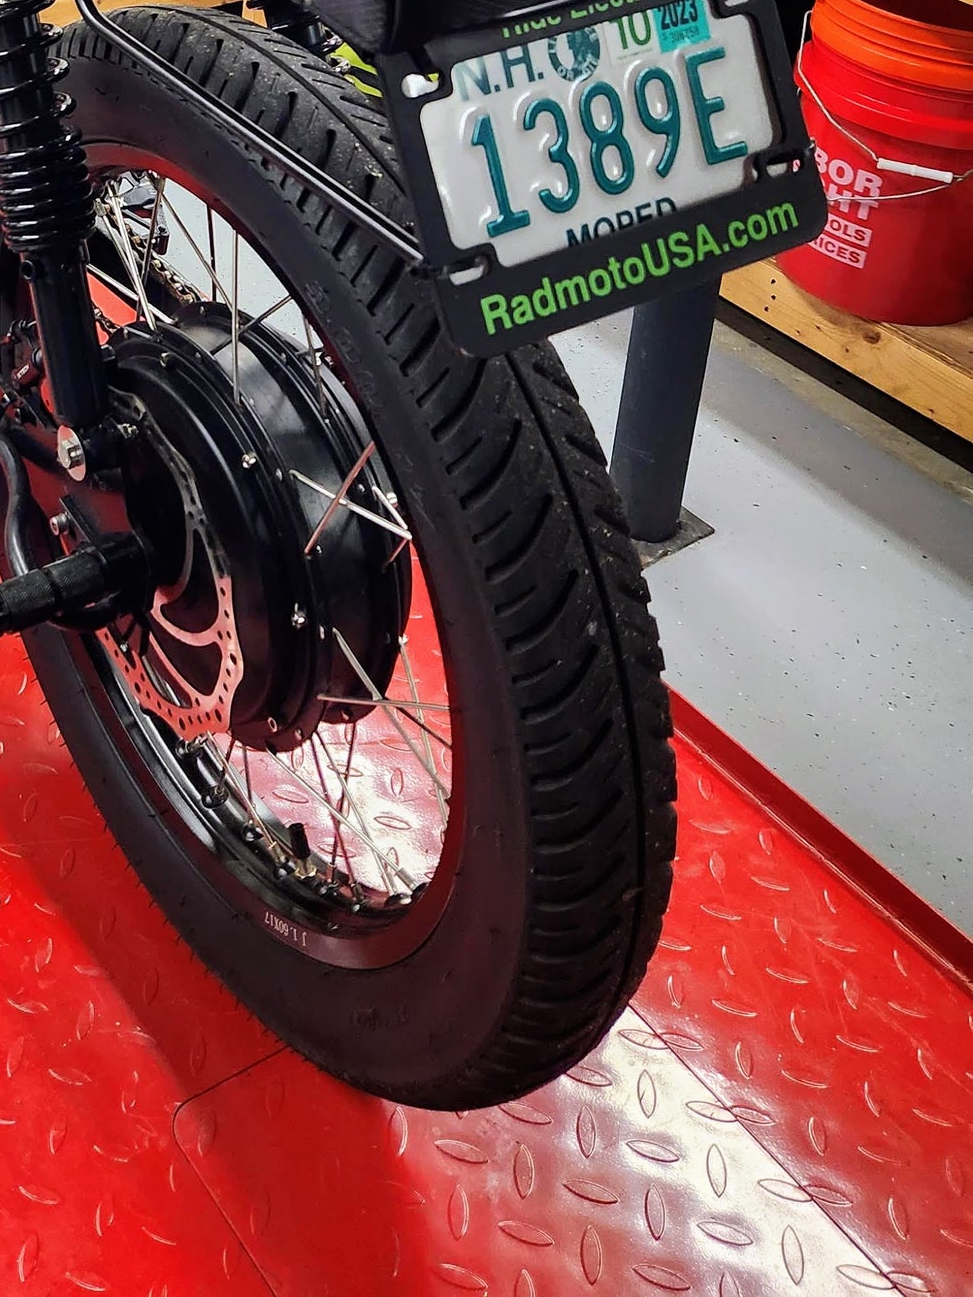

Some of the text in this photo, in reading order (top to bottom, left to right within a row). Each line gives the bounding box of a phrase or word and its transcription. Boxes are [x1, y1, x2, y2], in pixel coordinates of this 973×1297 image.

[609, 9, 652, 50] 10
[456, 48, 545, 101] N.H.
[471, 46, 749, 238] 1389E
[814, 146, 884, 198] BOR
[480, 202, 800, 336] RadmotoUSA.com
[814, 238, 861, 264] ICES
